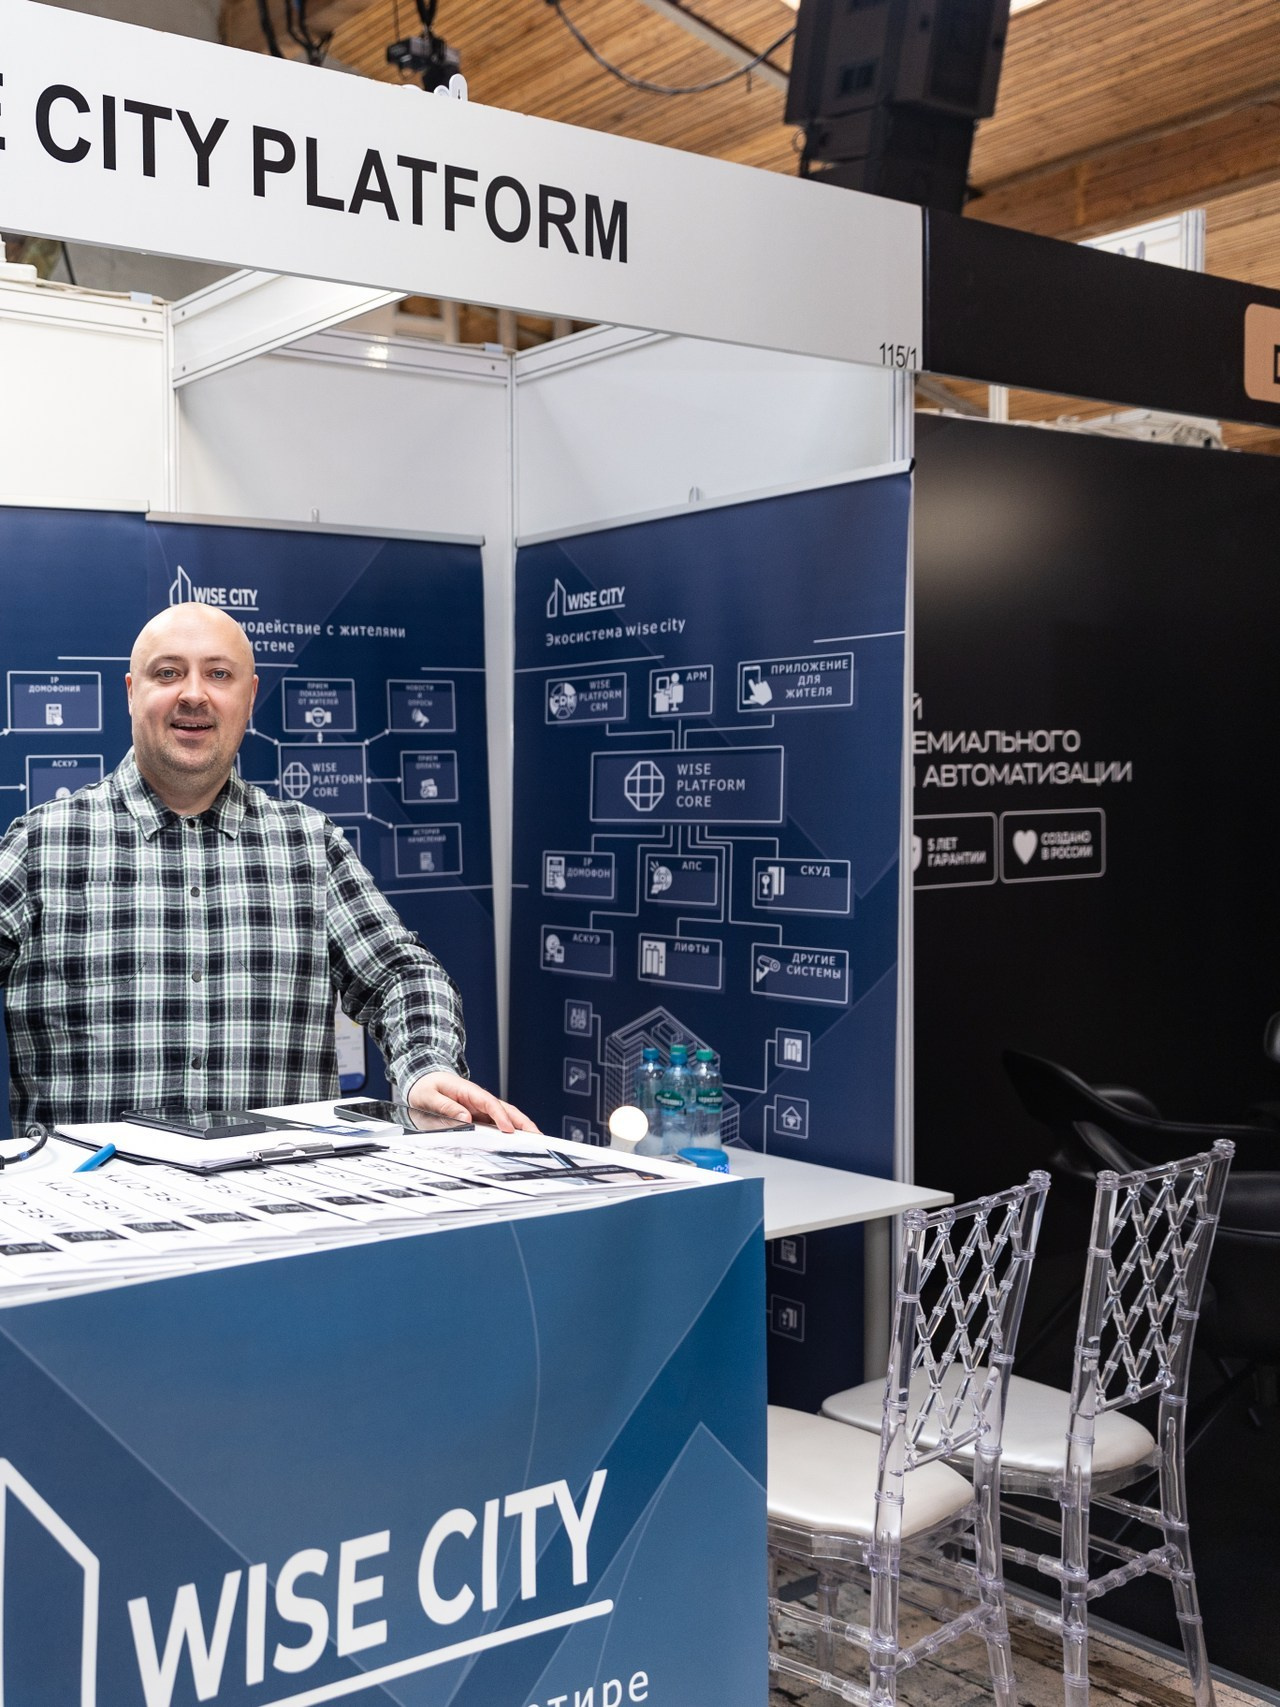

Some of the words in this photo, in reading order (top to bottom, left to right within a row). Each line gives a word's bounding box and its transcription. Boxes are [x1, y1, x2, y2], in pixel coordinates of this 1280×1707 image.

[35, 84, 229, 187] CITY
[253, 125, 627, 263] PLATFORM
[880, 342, 917, 370] 115/1
[192, 586, 227, 605] WISE
[229, 588, 258, 606] CITY
[567, 591, 597, 610] WISE
[599, 586, 626, 606] CITY
[326, 626, 334, 636] с
[340, 625, 406, 638] жителями
[545, 626, 623, 647] Экосистема
[625, 622, 658, 637] wise
[660, 618, 686, 634] city
[771, 659, 849, 674] ПРИЛОЖЕНИЕ
[50, 676, 60, 684] IP
[686, 671, 707, 681] АРМ
[797, 674, 821, 687] ДЛЯ
[28, 685, 81, 693] ДОМОФОНИЯ
[588, 679, 611, 689] WISE
[578, 689, 622, 702] PLATFORM
[785, 686, 833, 699] ЖИТЕЛЯ
[590, 702, 608, 712] CRM
[312, 762, 337, 773] WISE
[676, 763, 712, 775] WISE
[312, 774, 363, 785] PLATFORM
[922, 761, 1133, 788] АВТОМАТИЗАЦИИ
[312, 786, 339, 797] CORE
[676, 778, 746, 792] PLATFORM
[676, 795, 712, 808] CORE
[1040, 830, 1092, 845] СОЗДАНО
[927, 838, 935, 852] 5
[936, 837, 959, 851] ЛЕТ
[927, 850, 987, 867] ГАРАНТИИ
[1041, 847, 1050, 861] В
[1050, 845, 1093, 860] РОССИИ
[583, 857, 593, 865] IP
[681, 861, 703, 871] АПС
[566, 867, 611, 878] ДОМОФОН
[800, 865, 831, 877] СКУД
[572, 933, 601, 944] АСКУЭ
[674, 942, 710, 954] ЛИФТЫ
[792, 952, 836, 966] ДРУГИЕ
[786, 964, 841, 980] СИСТЕМЫ
[127, 1529, 391, 1707] WISE
[417, 1469, 608, 1625] CITY
